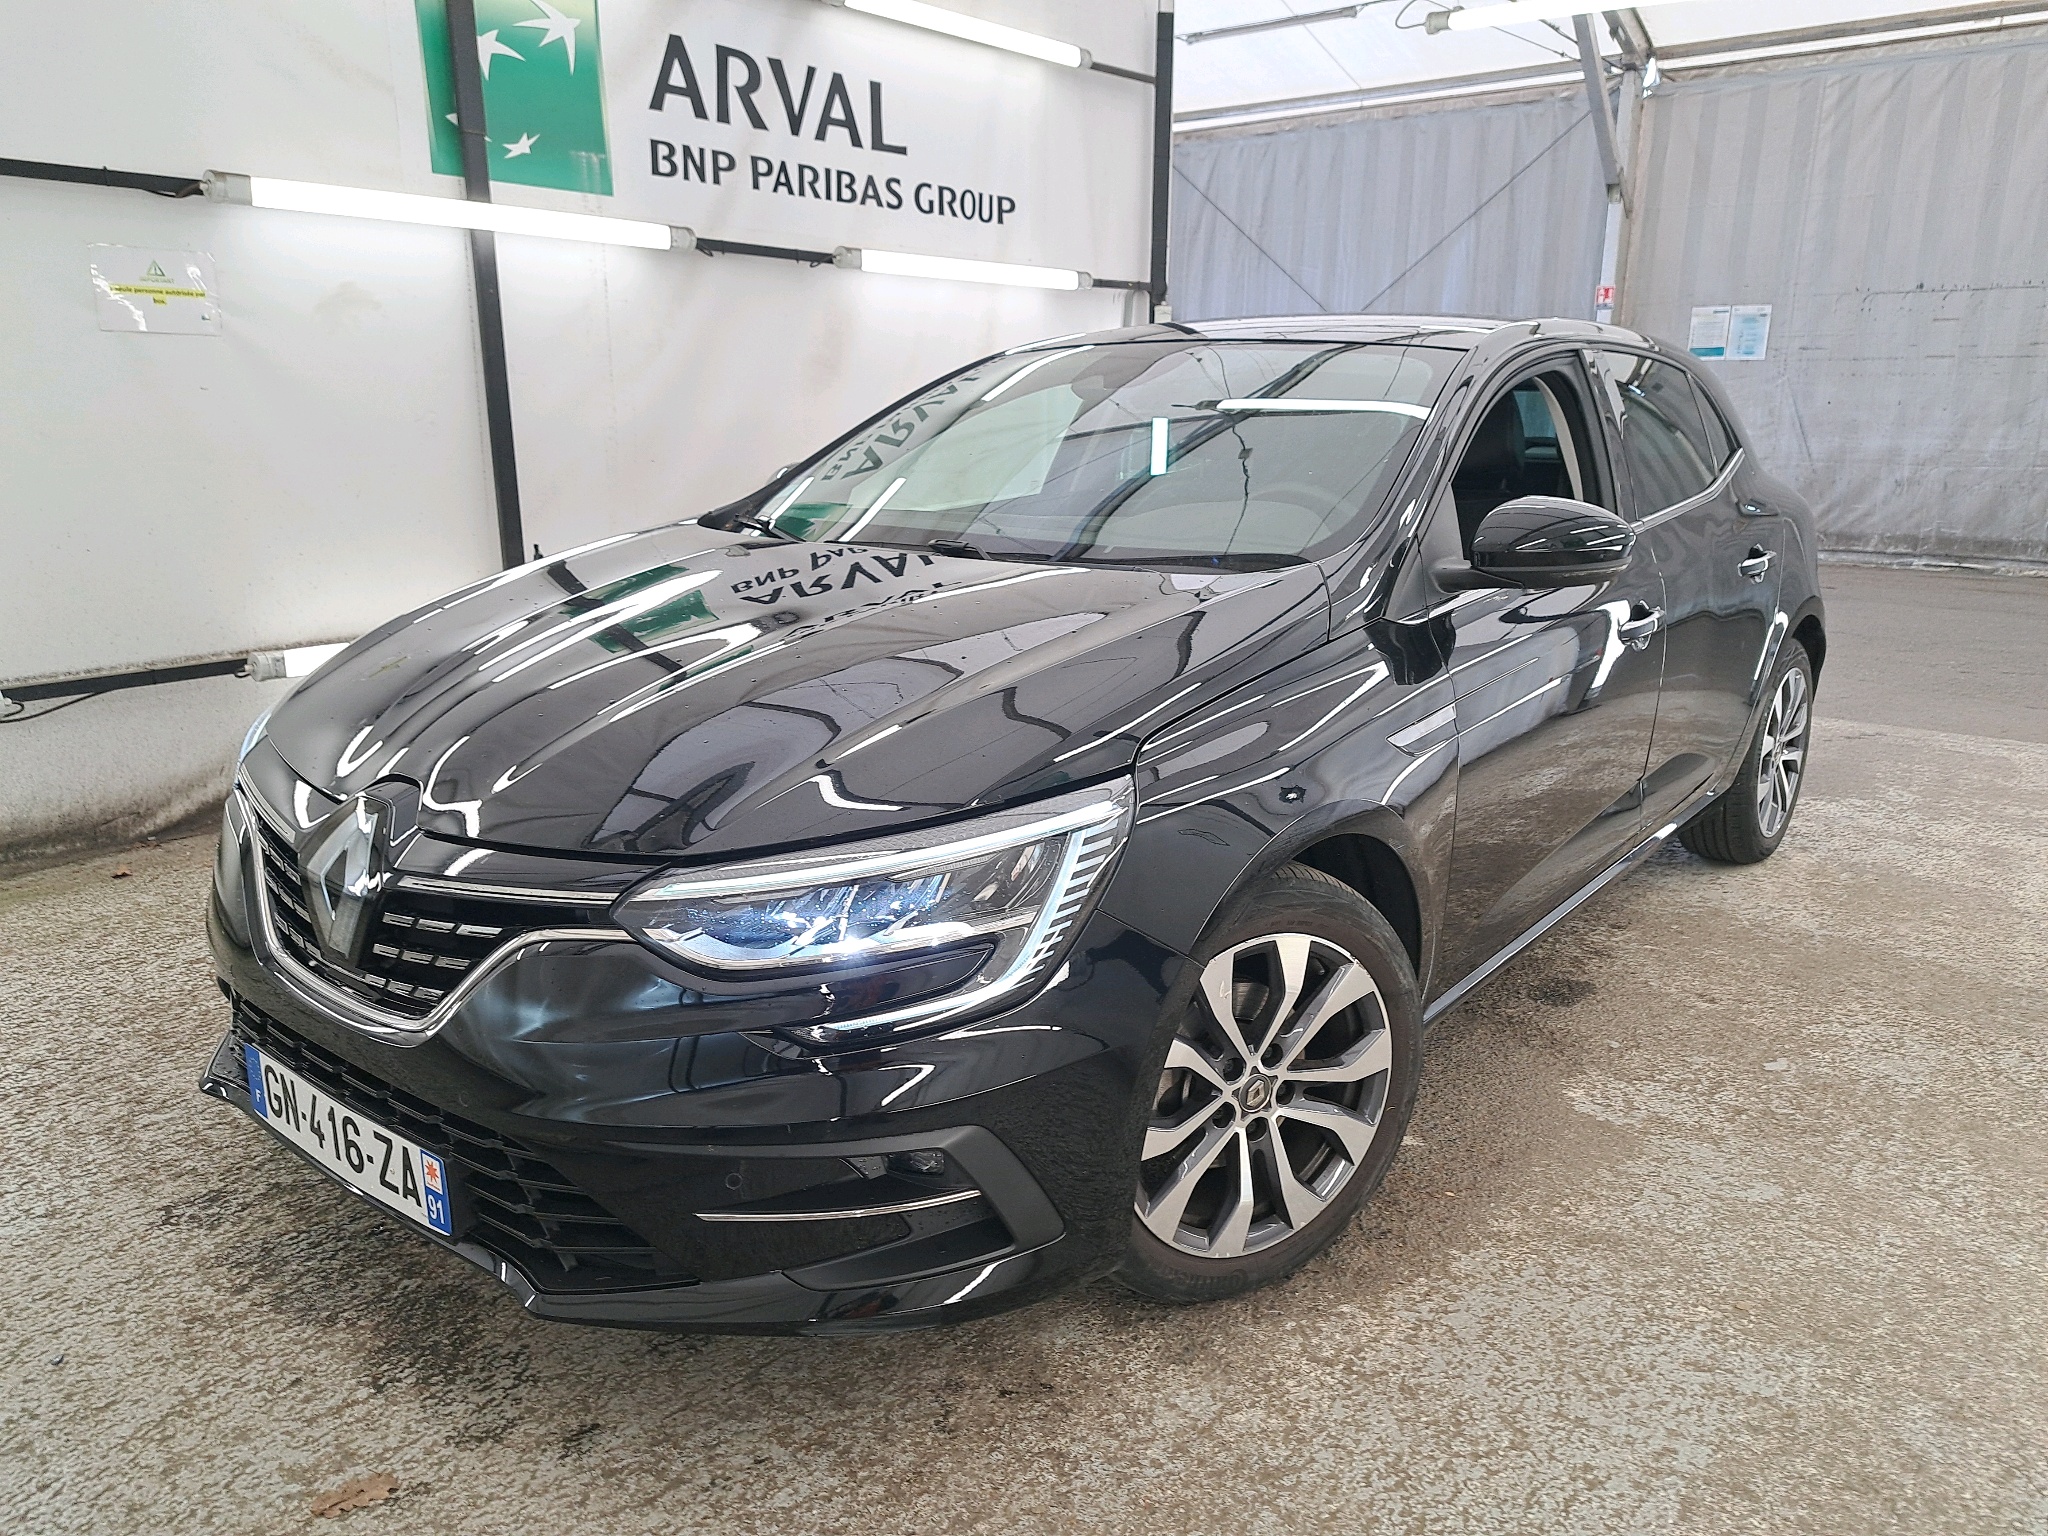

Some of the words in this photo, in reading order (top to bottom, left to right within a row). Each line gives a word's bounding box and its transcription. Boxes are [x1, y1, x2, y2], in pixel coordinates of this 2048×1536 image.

[649, 34, 907, 155] ARVAL
[650, 138, 736, 185] BNP
[752, 156, 903, 210] PARIBAS
[914, 183, 1016, 225] GROUP
[255, 1089, 262, 1103] F
[264, 1064, 422, 1208] GN-416-ZA
[427, 1194, 445, 1225] 91
